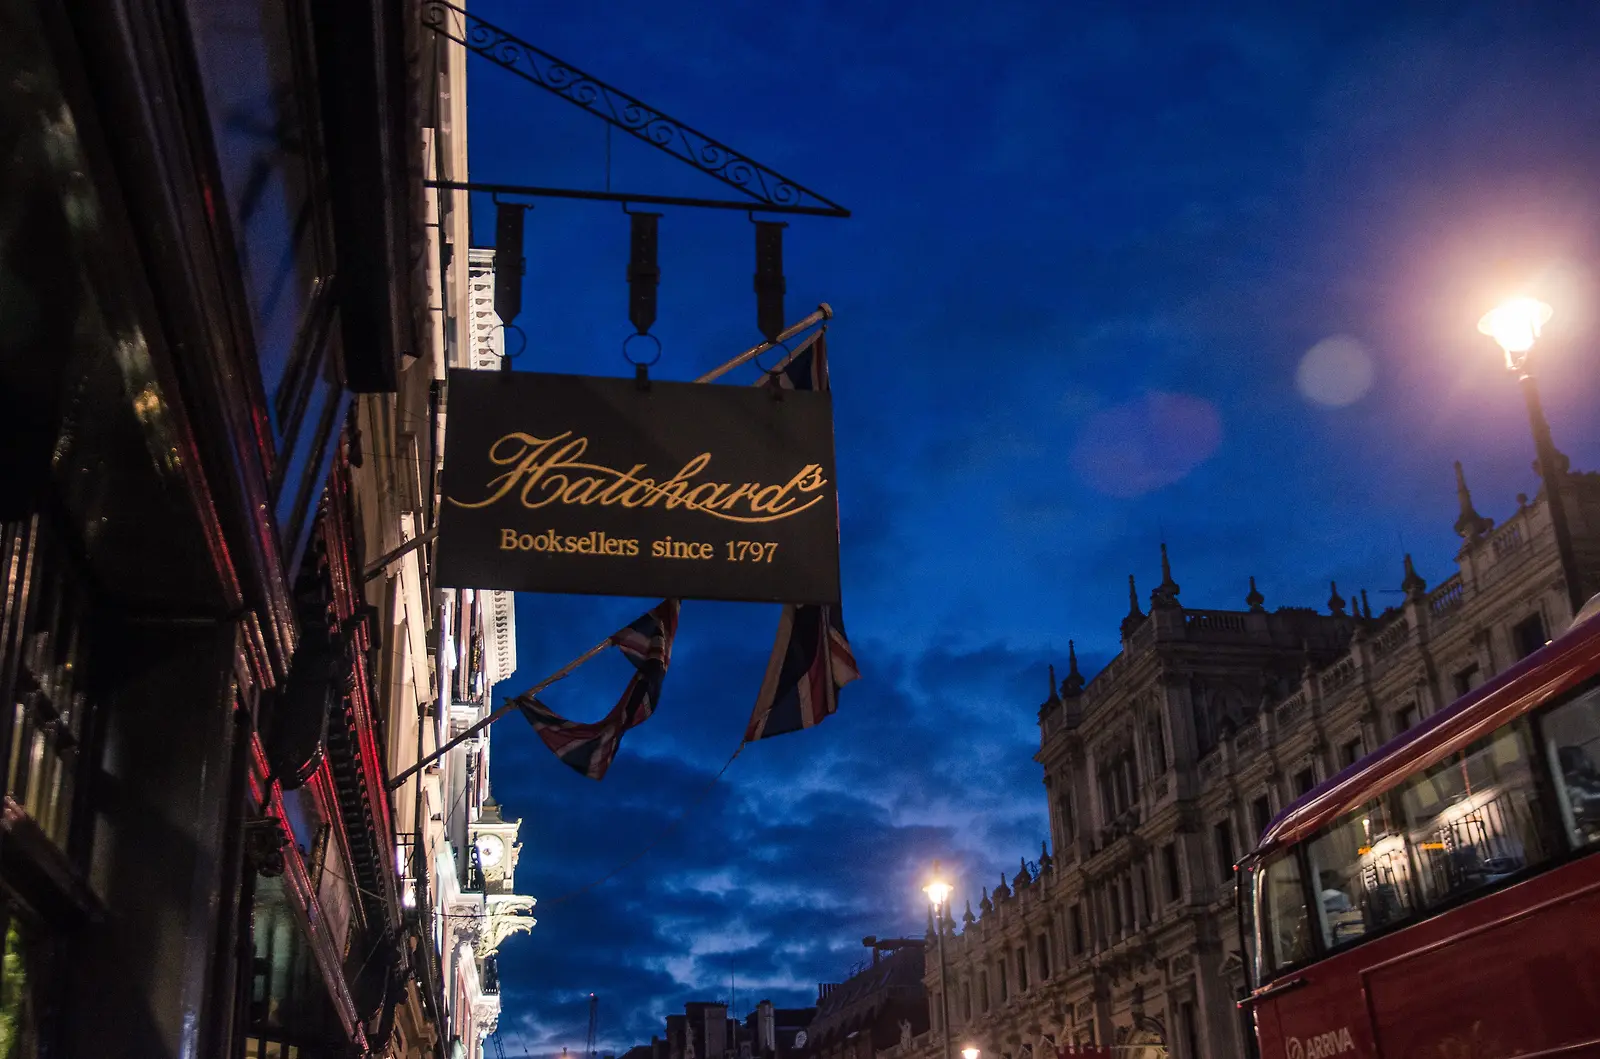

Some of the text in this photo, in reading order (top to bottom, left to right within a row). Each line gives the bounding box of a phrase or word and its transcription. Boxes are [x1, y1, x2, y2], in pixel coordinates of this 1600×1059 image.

[500, 528, 778, 564] Booksellers since 1797
[1306, 1027, 1355, 1059] ARRIVA
